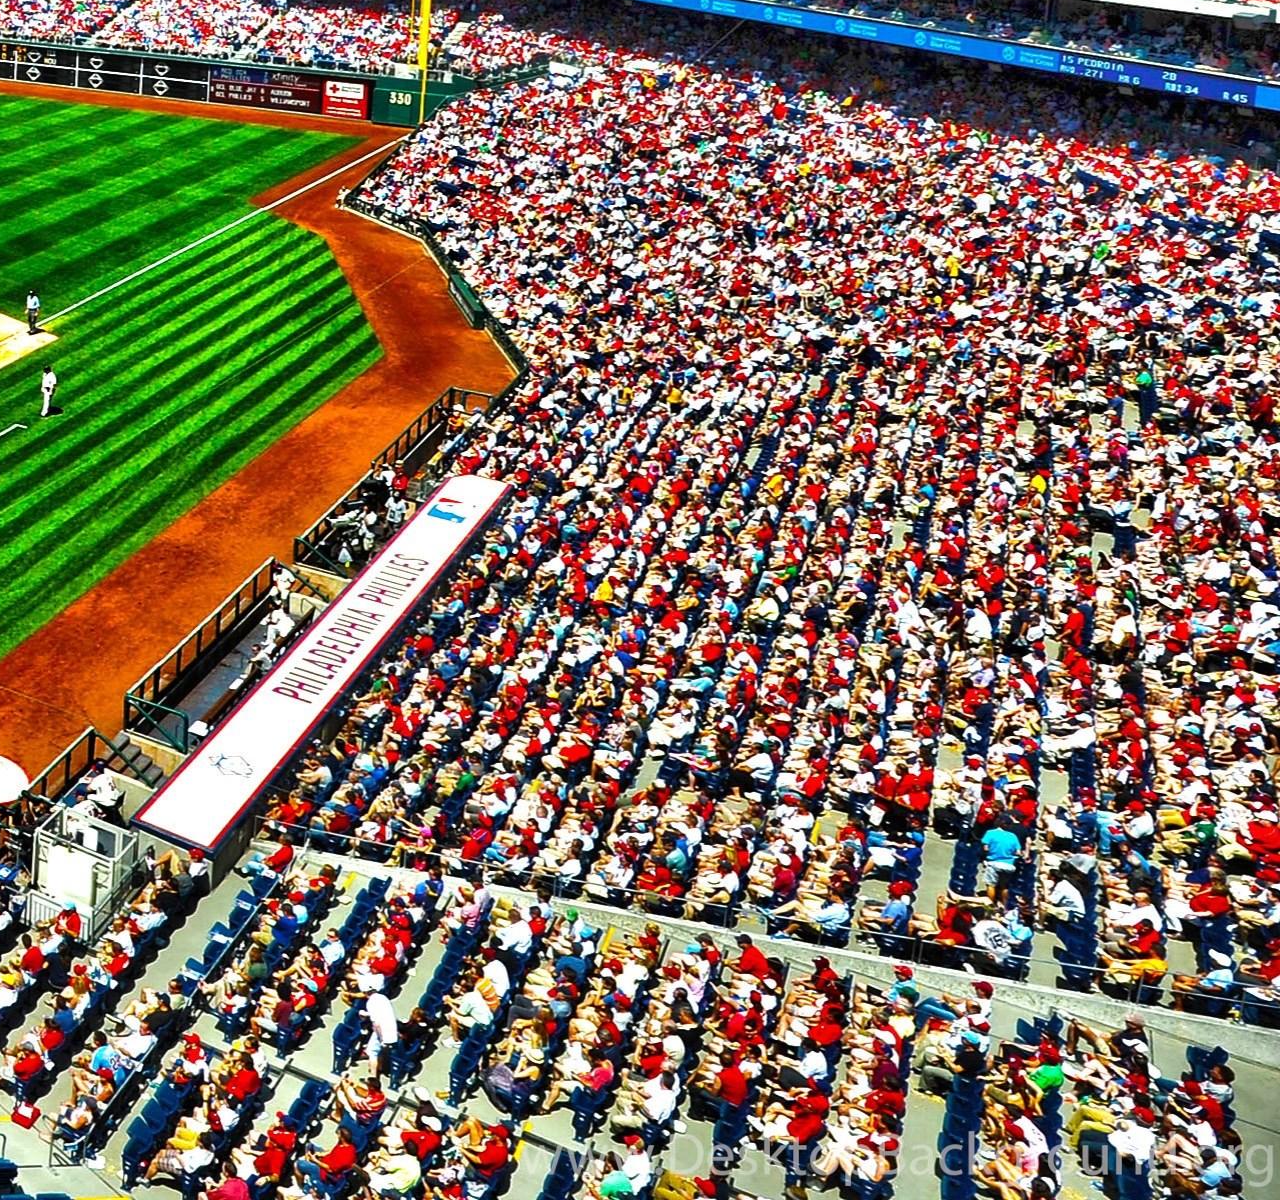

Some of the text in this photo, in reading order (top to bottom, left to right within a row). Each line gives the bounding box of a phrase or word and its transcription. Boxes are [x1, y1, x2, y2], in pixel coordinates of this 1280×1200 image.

[1062, 55, 1124, 72] 15 PEDROIA
[271, 71, 300, 84] xfinity
[1132, 76, 1140, 85] 6
[1162, 72, 1177, 81] 2B
[389, 92, 412, 105] 330
[1184, 84, 1199, 95] 34
[1231, 92, 1248, 104] 45
[271, 553, 431, 705] PHILADELPHIA PHILLIES
